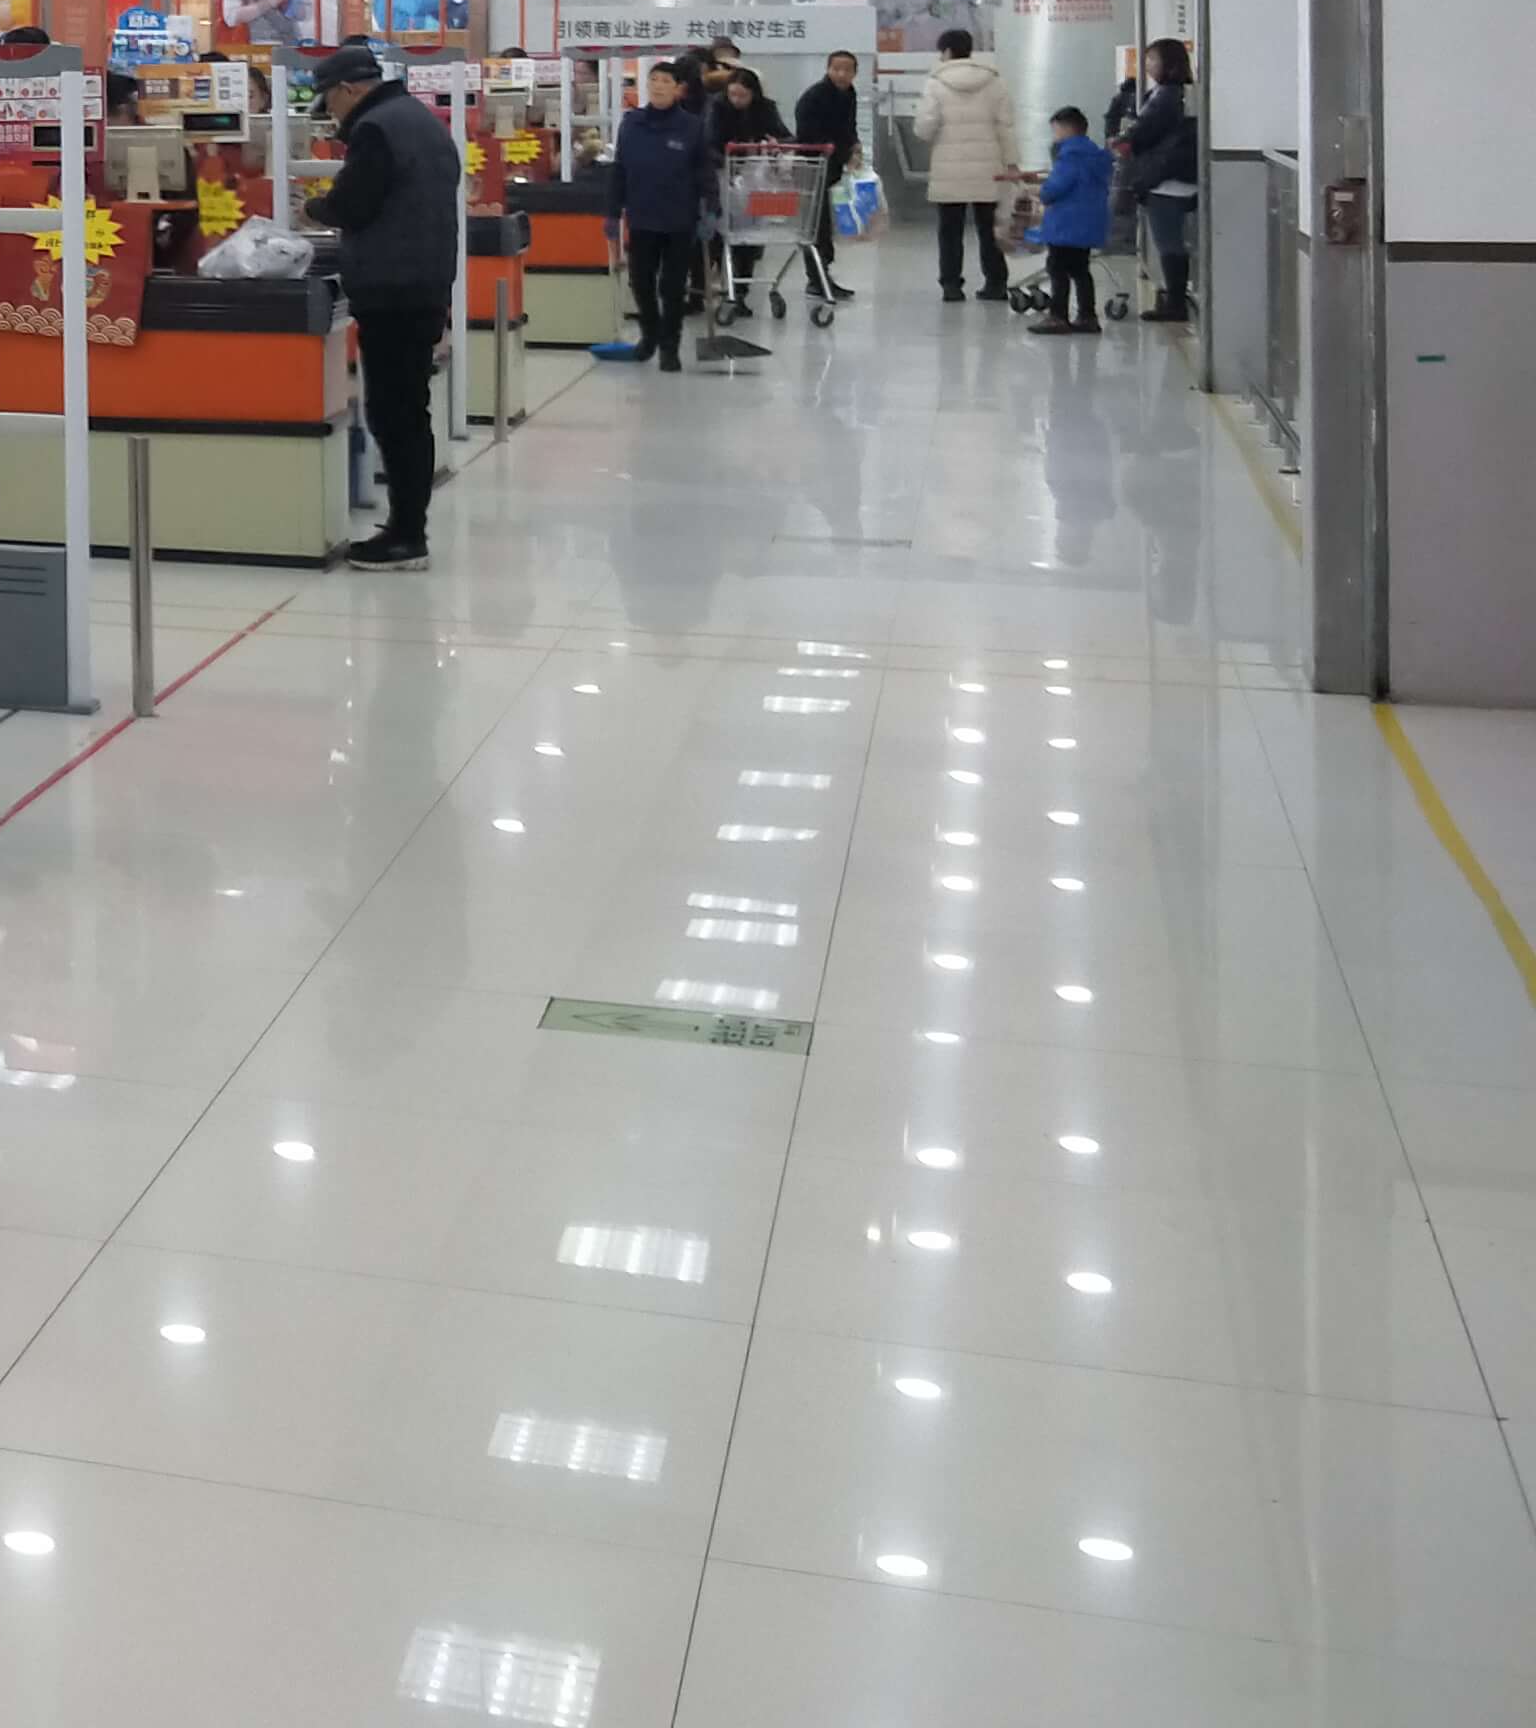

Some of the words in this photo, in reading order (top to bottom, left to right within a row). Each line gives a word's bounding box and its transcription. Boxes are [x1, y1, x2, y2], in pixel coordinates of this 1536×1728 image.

[558, 20, 671, 39] 引领商业进步
[686, 20, 808, 39] 共创美好生活
